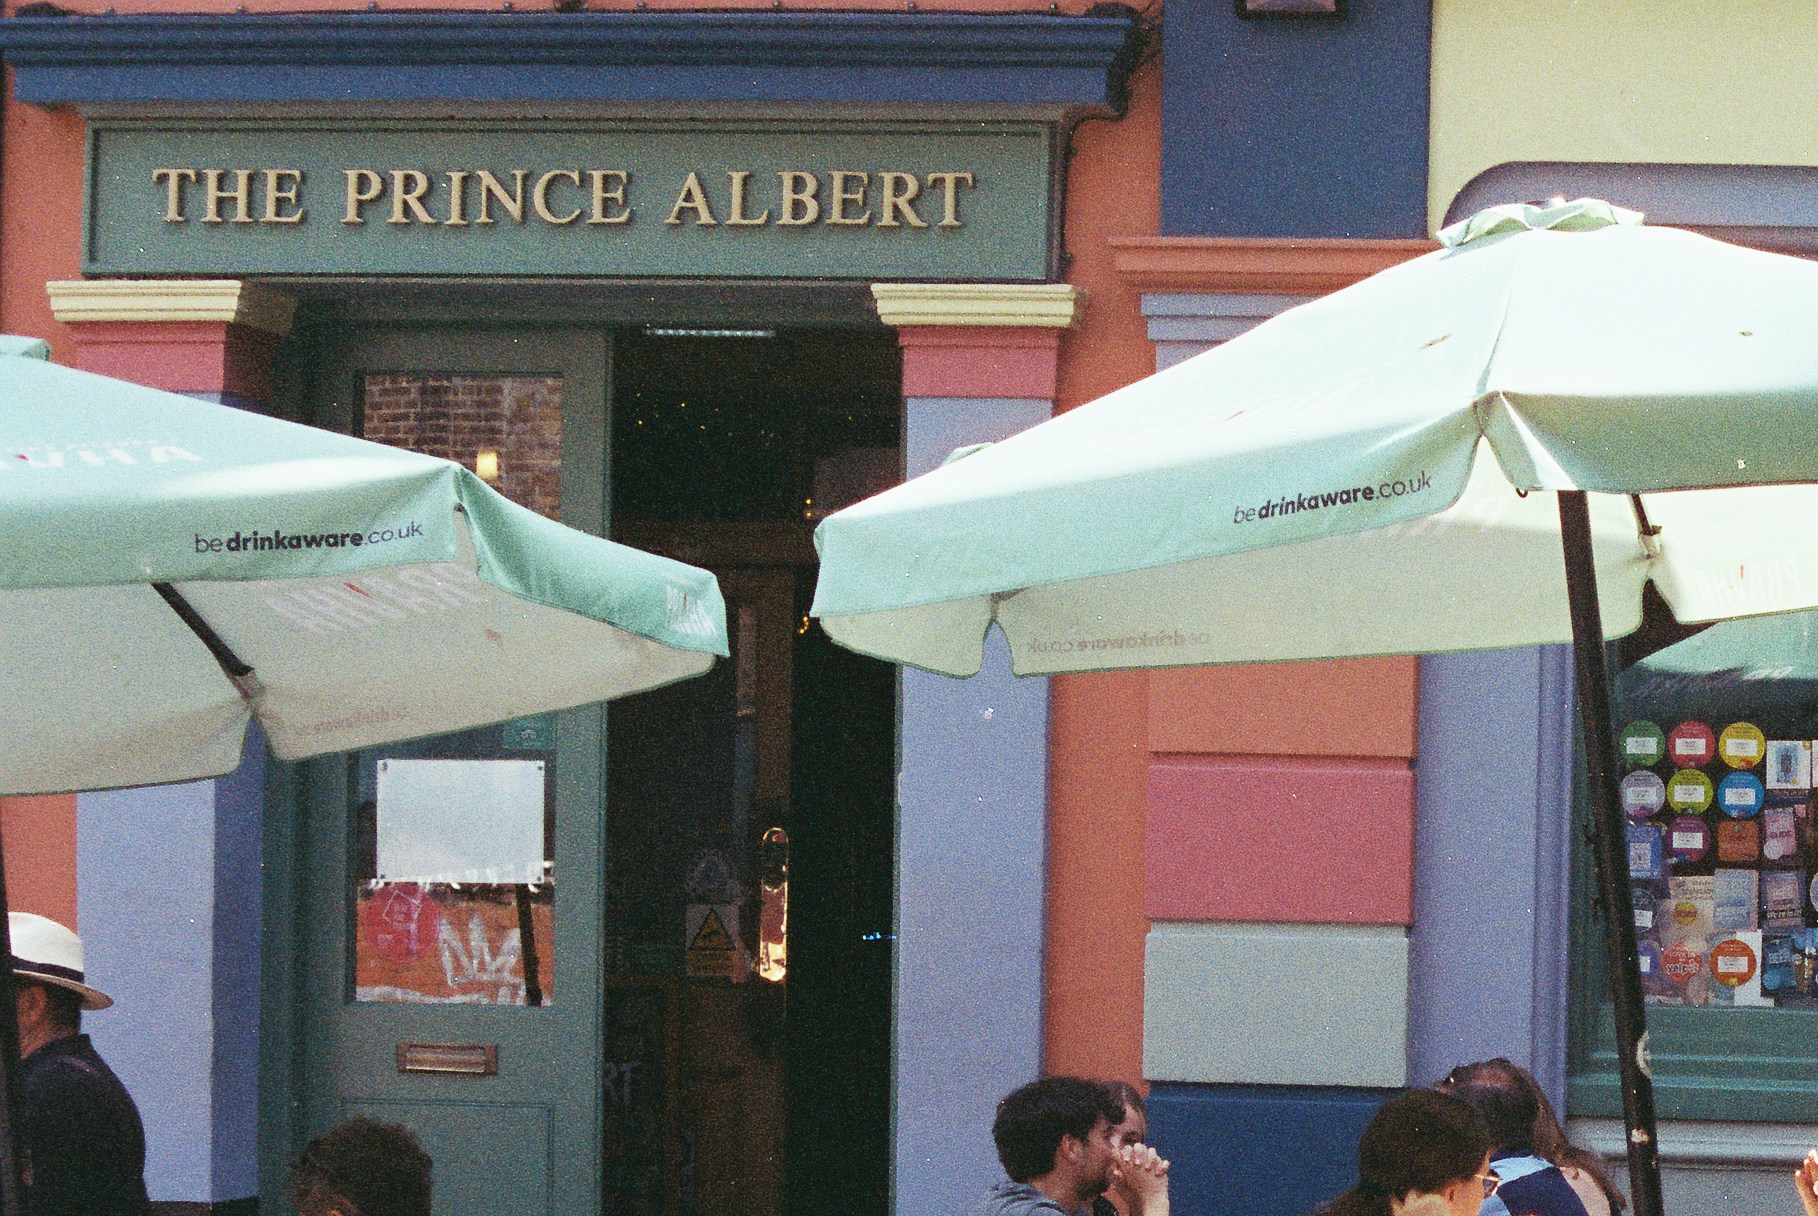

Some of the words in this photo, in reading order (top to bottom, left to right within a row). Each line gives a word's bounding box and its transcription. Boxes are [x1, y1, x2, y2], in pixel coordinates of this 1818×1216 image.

[152, 167, 306, 225] THE
[341, 168, 632, 227] PRINCE
[663, 170, 976, 229] ALBERT
